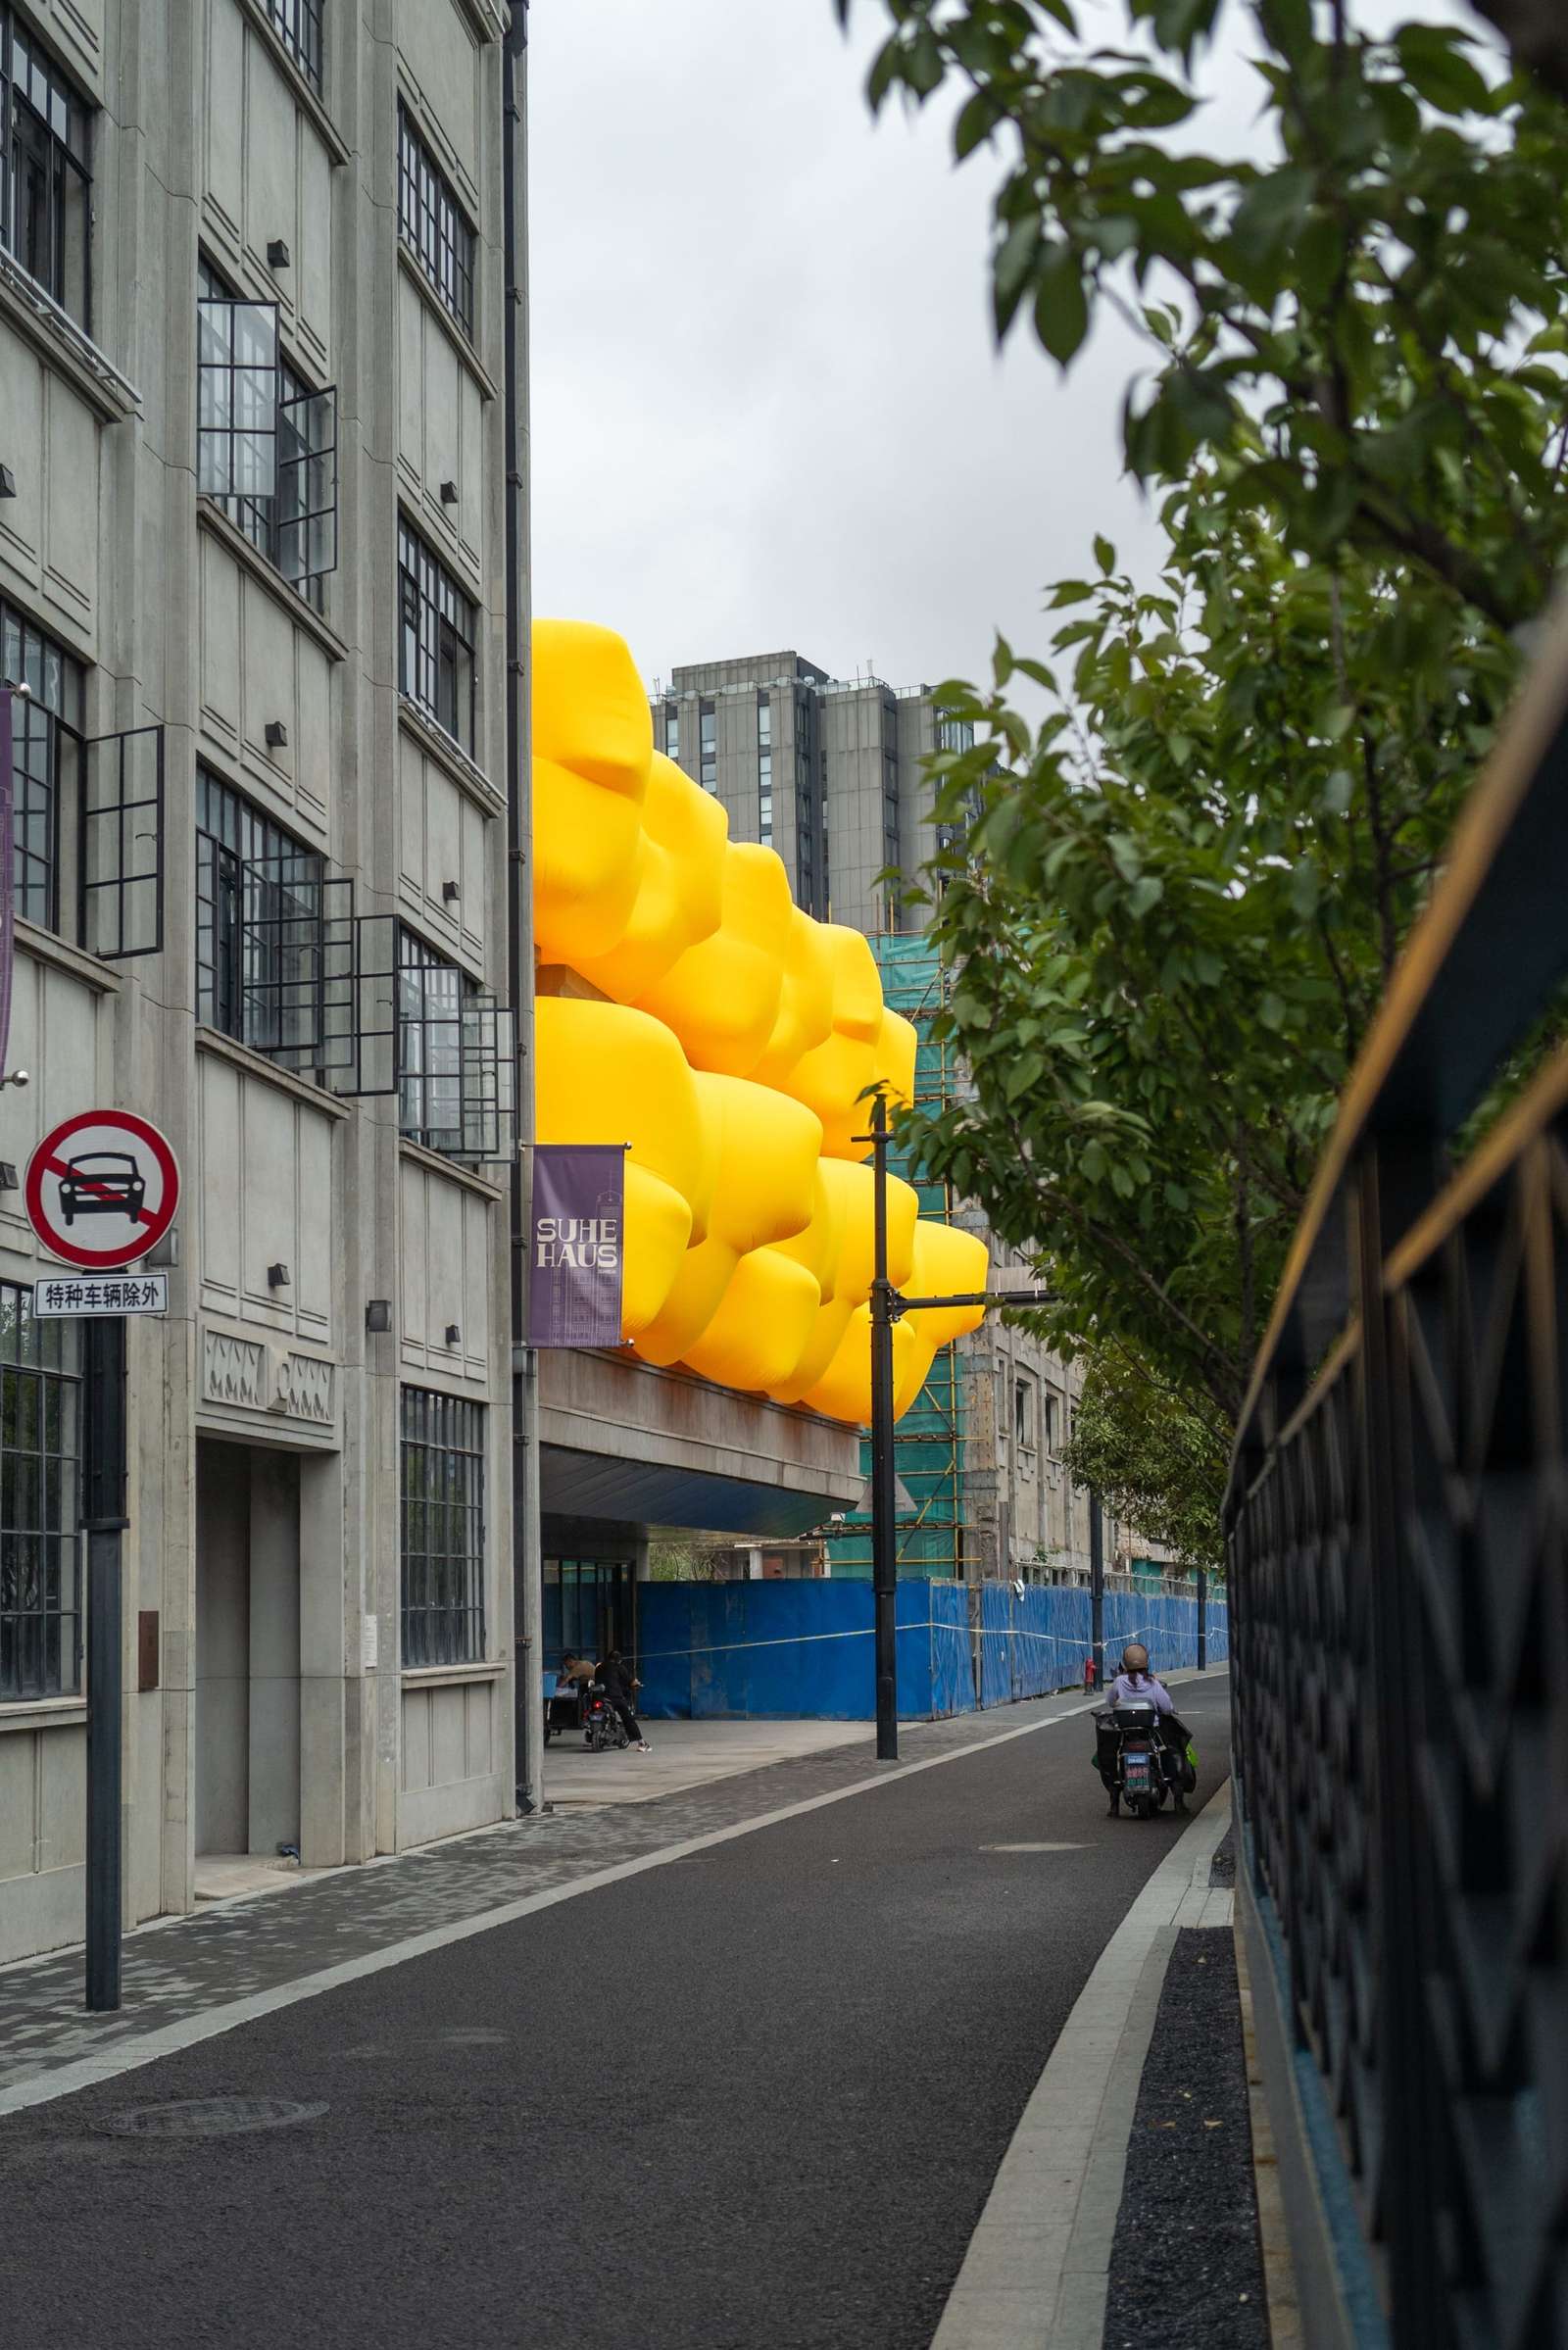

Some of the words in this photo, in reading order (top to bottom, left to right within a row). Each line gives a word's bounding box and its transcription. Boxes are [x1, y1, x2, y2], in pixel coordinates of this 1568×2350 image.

[537, 1218, 617, 1244] SUHE
[536, 1244, 617, 1268] HAUS
[45, 1281, 159, 1309] 特种车辆除外
